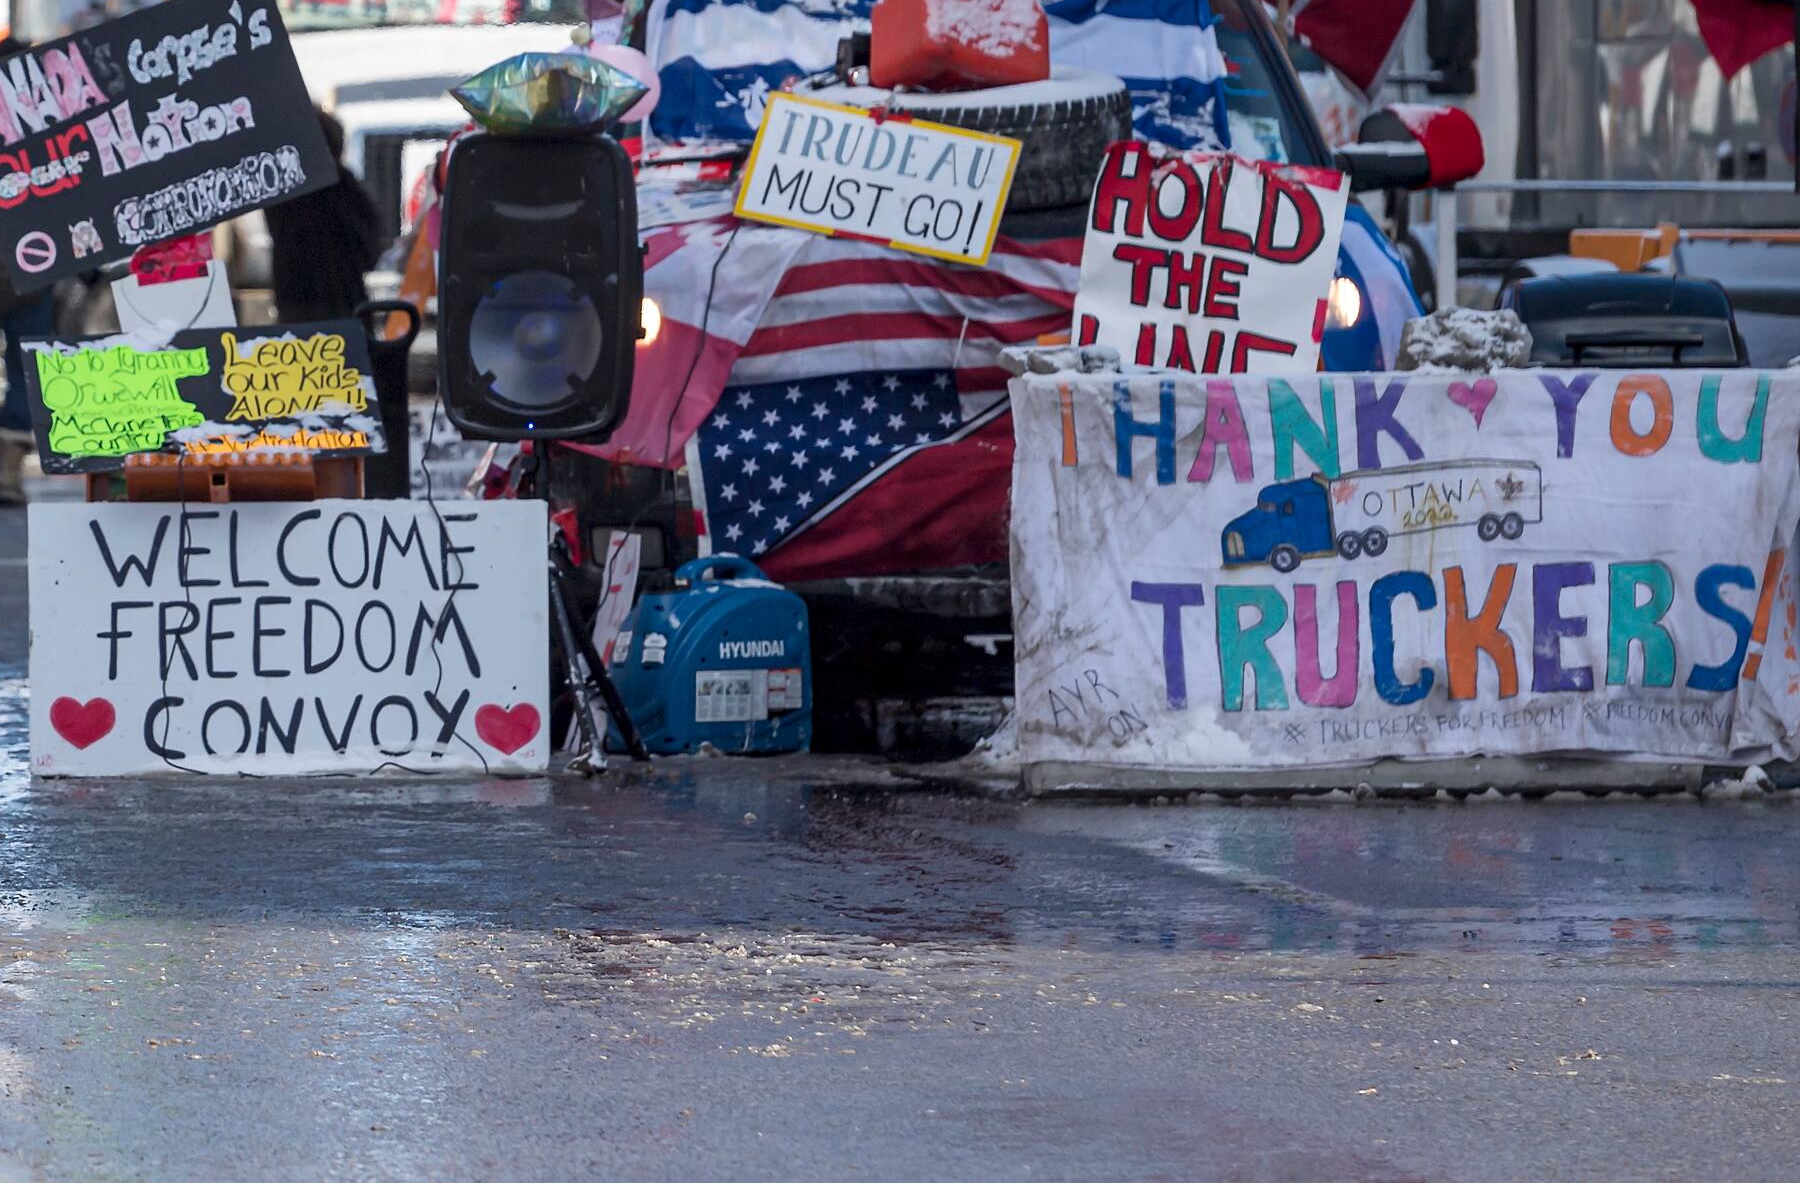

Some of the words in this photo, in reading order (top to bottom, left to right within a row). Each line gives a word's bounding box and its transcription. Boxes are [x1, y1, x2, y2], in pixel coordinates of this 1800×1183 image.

[89, 93, 256, 177] Nation
[775, 111, 998, 190] TRUDEAU
[761, 166, 894, 228] MUST
[904, 195, 986, 257] GO!
[1093, 151, 1326, 264] HOLD
[1113, 245, 1249, 321] THE
[228, 334, 342, 368] Leave
[299, 363, 360, 392] Kids
[1536, 373, 1775, 467] YOU
[1362, 477, 1490, 517] OTTAWA
[89, 509, 479, 591] WELCOME
[97, 596, 481, 680] FREEDOM
[719, 640, 785, 660] HYUNDAI
[143, 688, 470, 760] CONVOY
[1048, 669, 1120, 729] AYR
[1437, 710, 1473, 732] FOR
[1478, 704, 1565, 733] FREEDOM
